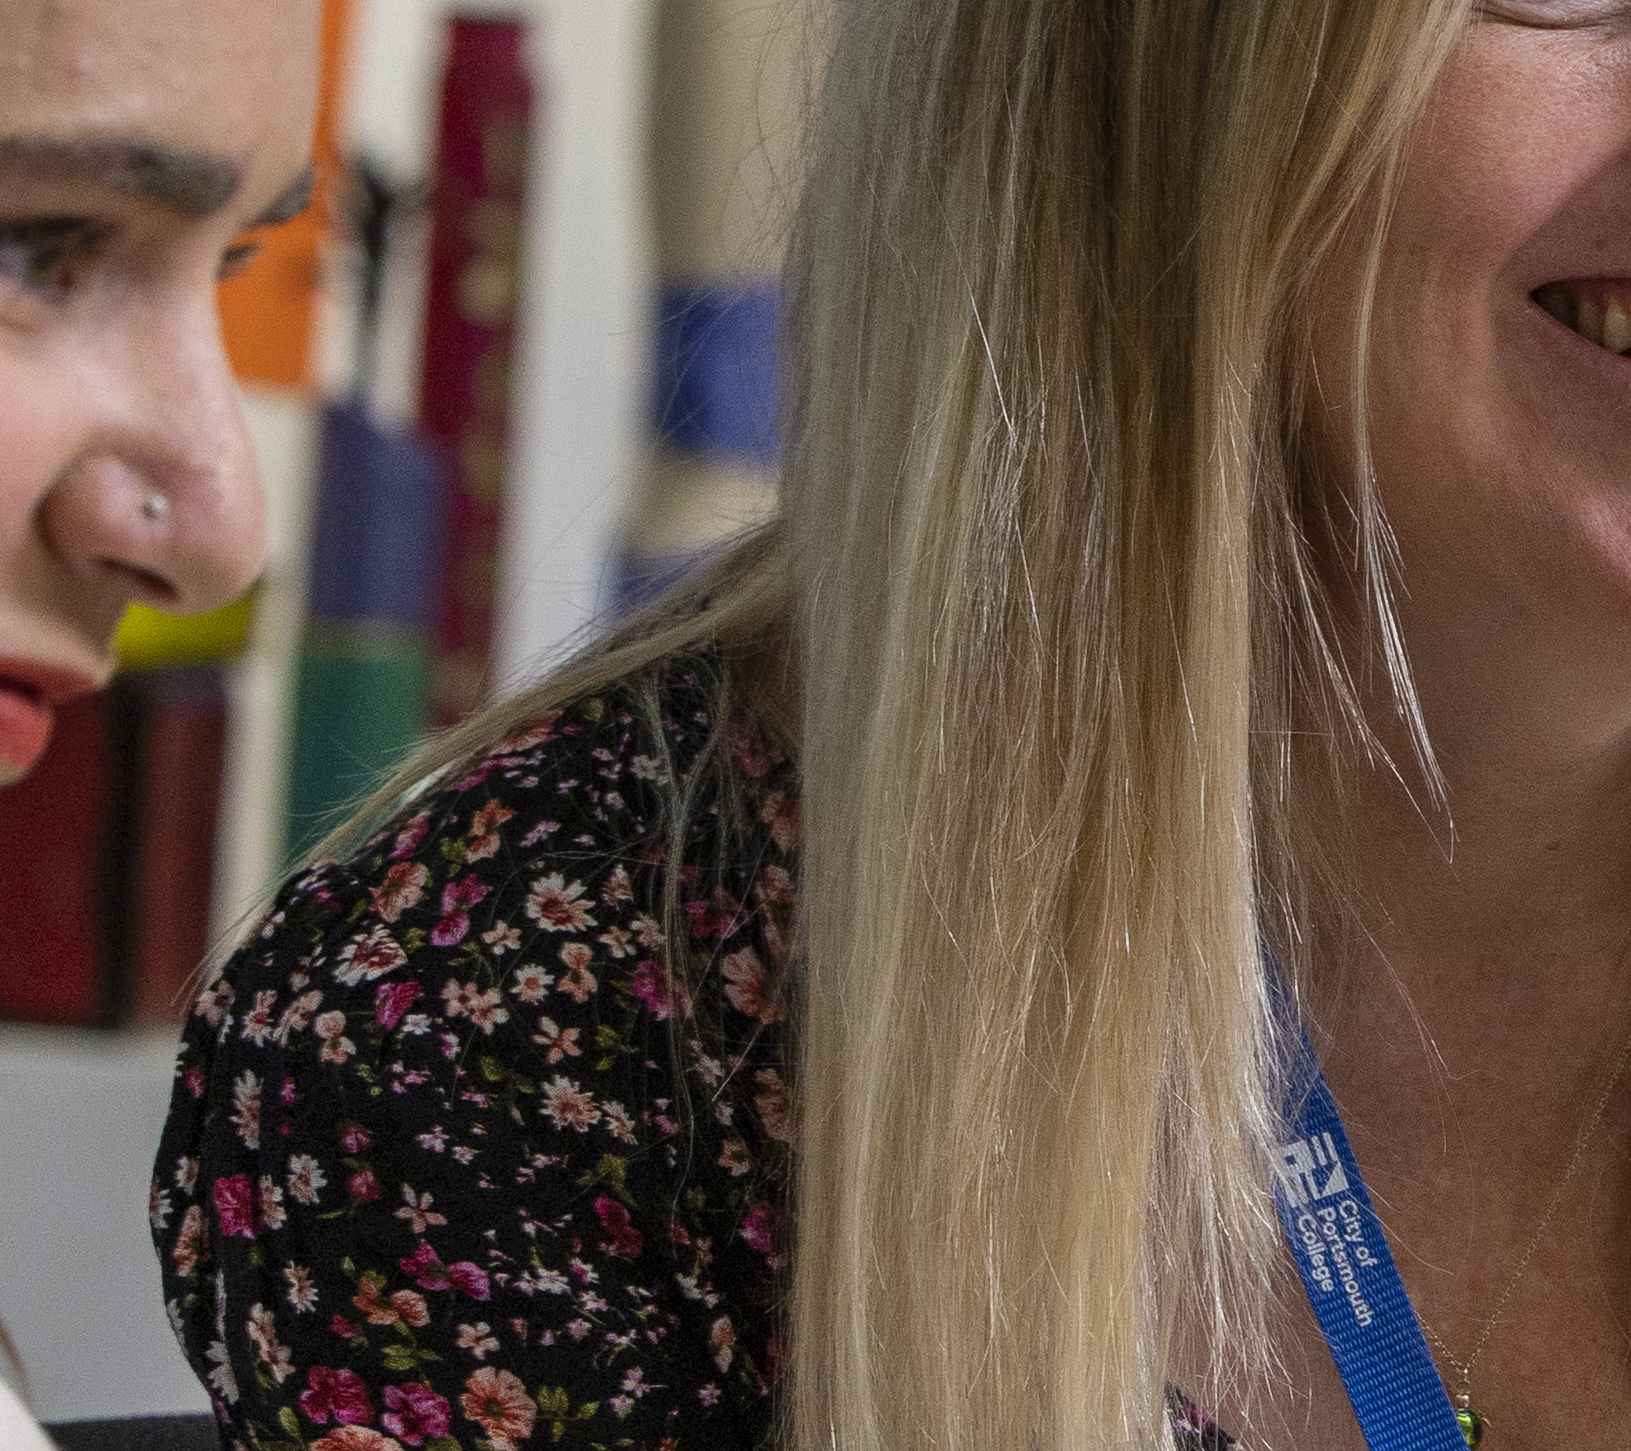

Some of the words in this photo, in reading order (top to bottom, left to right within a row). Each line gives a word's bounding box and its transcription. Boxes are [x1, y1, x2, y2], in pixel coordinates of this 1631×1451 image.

[1298, 1213, 1334, 1292] College
[1317, 1206, 1374, 1327] Portsmouth
[1339, 1200, 1364, 1243] City
[1355, 1246, 1378, 1267] of
